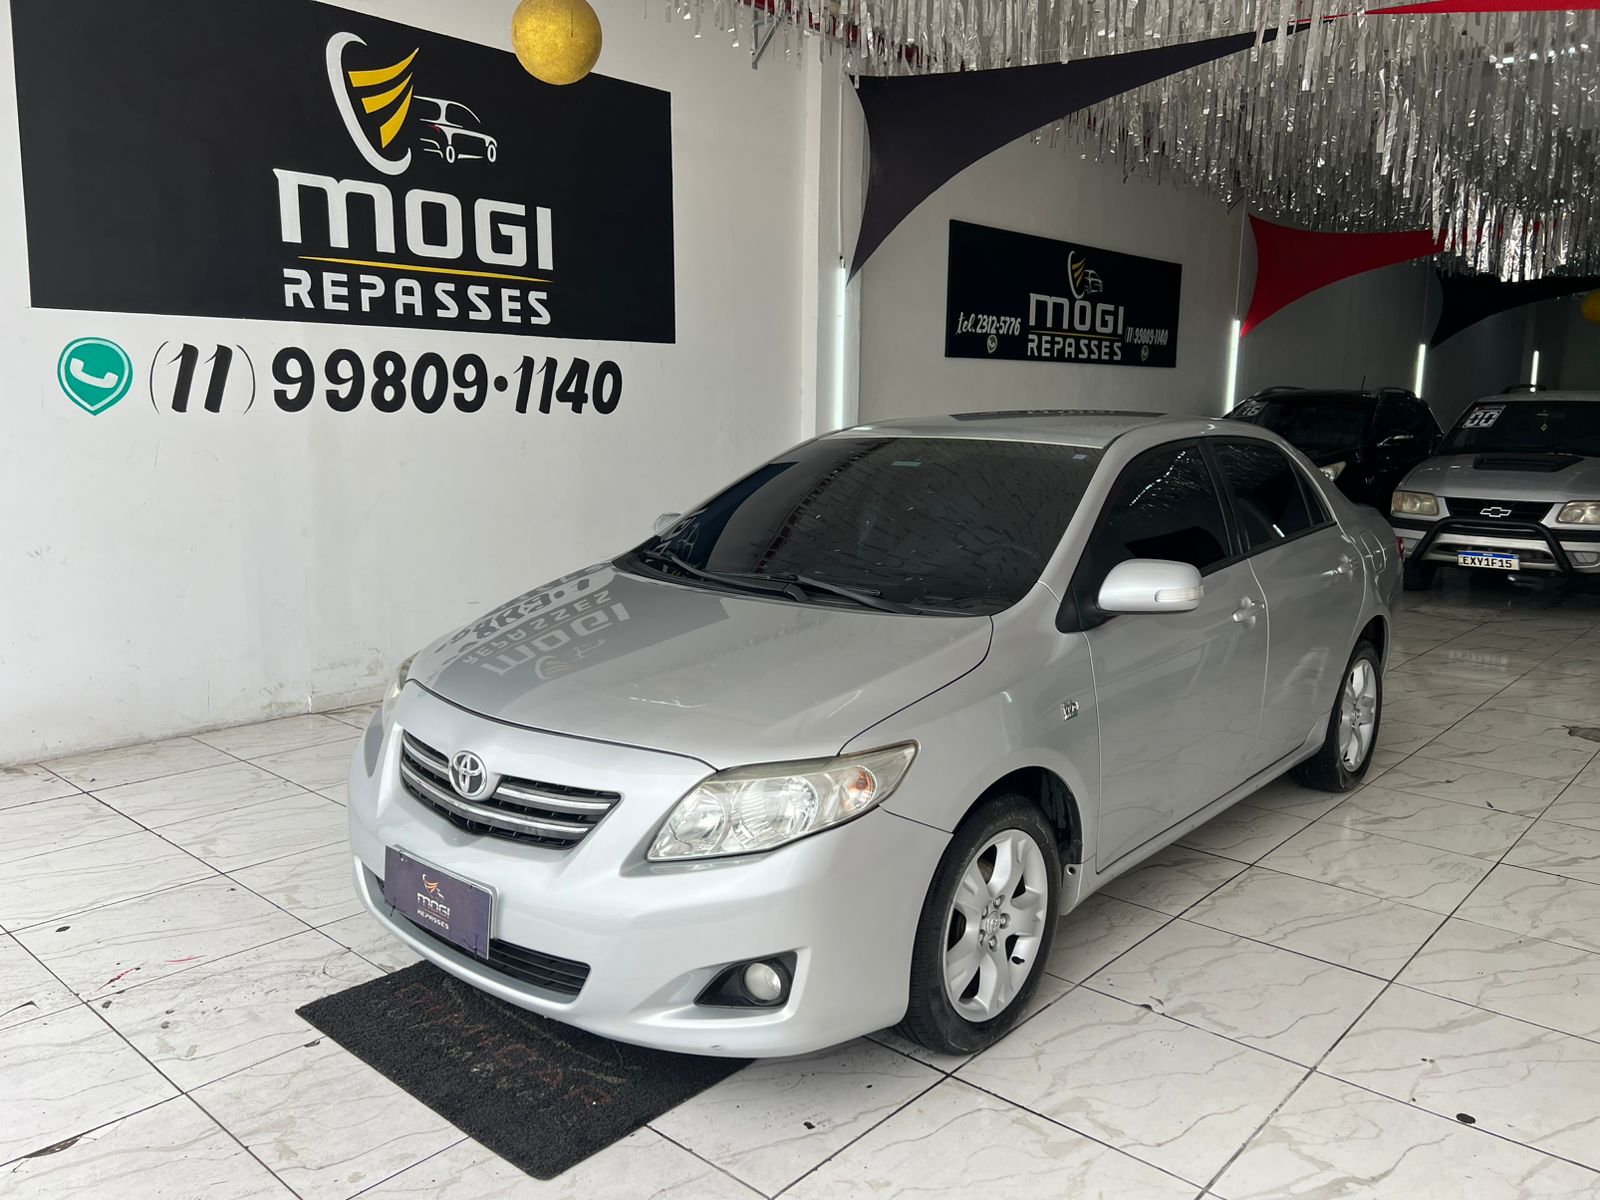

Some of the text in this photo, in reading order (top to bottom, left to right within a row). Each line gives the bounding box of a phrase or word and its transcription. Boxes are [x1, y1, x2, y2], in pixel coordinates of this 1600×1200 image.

[272, 167, 554, 271] MOGI
[283, 267, 552, 326] REPASSES
[1028, 292, 1124, 335] MOGI
[1027, 334, 1122, 360] REPASSES
[148, 340, 256, 415] (11)
[1462, 556, 1512, 568] EXY1F15
[416, 892, 450, 918] MOGI
[416, 908, 450, 930] REPASSES
